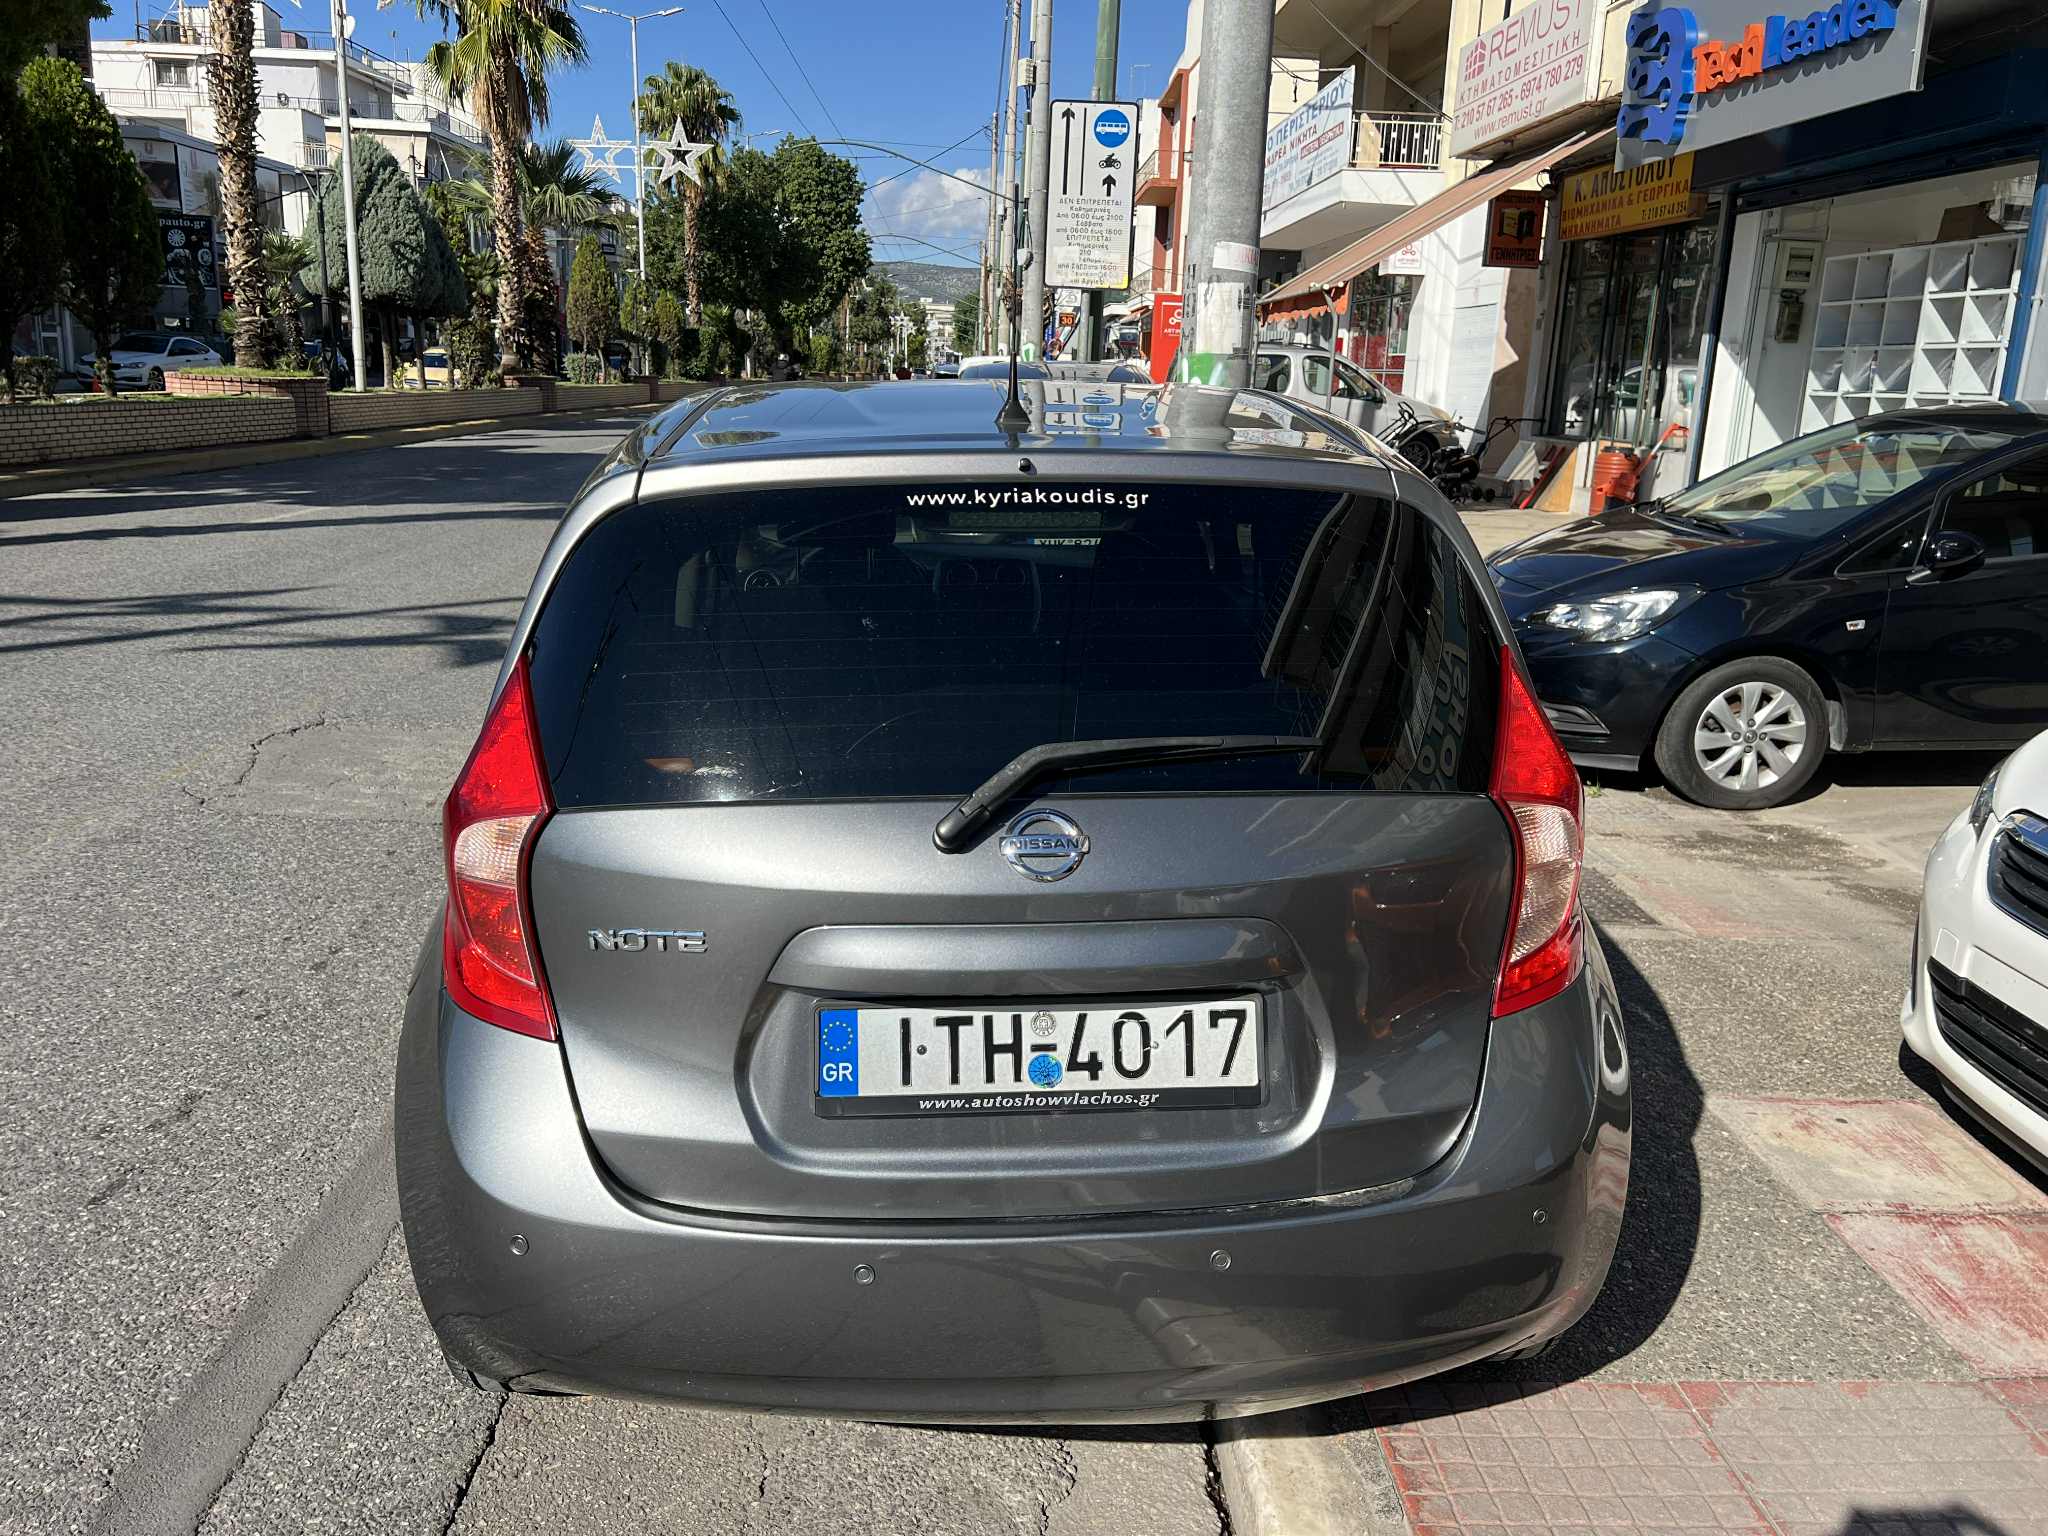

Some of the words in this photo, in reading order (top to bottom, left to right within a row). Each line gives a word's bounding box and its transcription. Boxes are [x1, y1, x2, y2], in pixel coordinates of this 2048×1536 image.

[1459, 29, 1581, 105] ΚΤΗΜΑΤΟΜΕΣΙΤΙΚΗ
[1498, 89, 1514, 112] 265
[1520, 76, 1542, 100] 6974
[1545, 65, 1562, 90] 780
[1563, 54, 1584, 82] 279
[1474, 97, 1548, 140] www.remust.gr
[906, 488, 1149, 508] www.kyriakoudis.gr
[1009, 837, 1079, 849] NISSAN
[587, 928, 709, 952] NOTE
[822, 1063, 853, 1083] GR
[918, 1091, 1160, 1110] www.autoshowvlachos.gr
